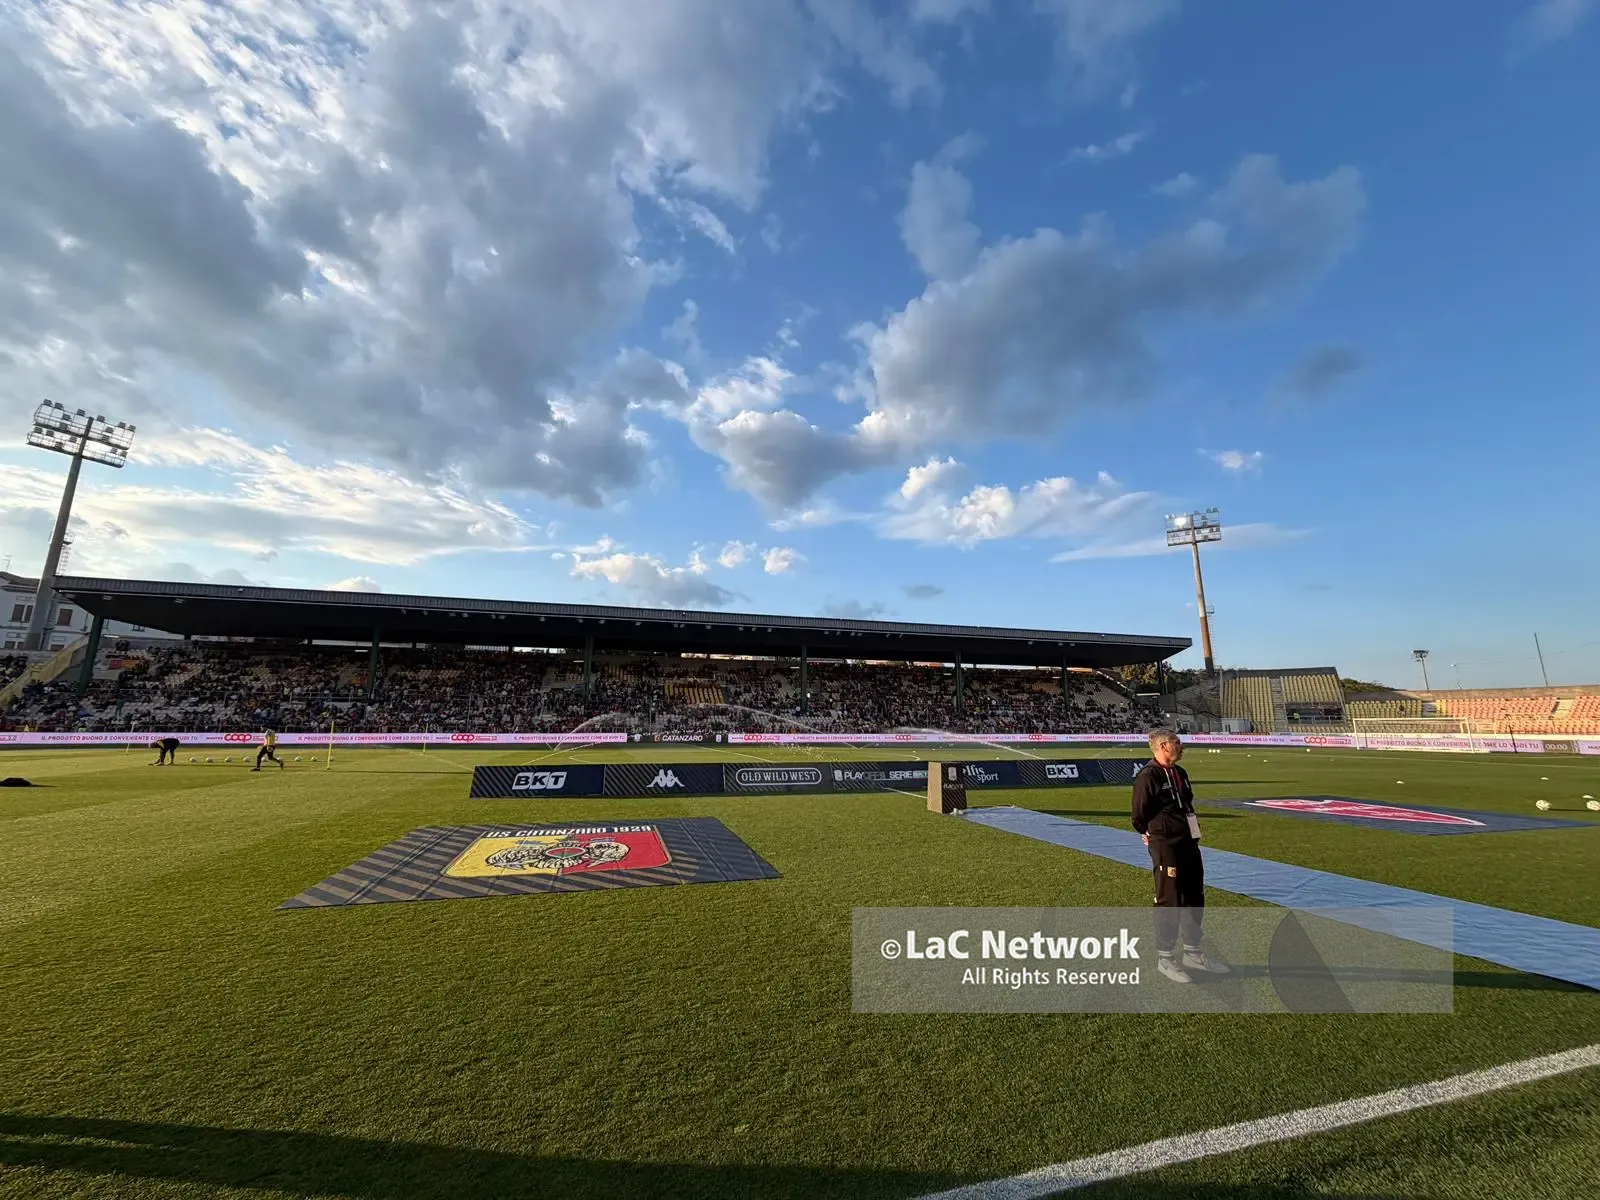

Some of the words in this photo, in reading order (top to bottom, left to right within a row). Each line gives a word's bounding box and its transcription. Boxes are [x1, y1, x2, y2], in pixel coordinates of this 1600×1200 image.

[224, 733, 252, 743] coop
[451, 733, 475, 743] coop
[895, 734, 912, 742] coop
[1304, 736, 1327, 746] coop
[741, 772, 761, 782] OLD
[763, 772, 788, 782] WILD
[789, 771, 817, 781] WEST
[889, 770, 913, 779] SERIE
[1045, 764, 1079, 779] BKT
[512, 771, 567, 790] BKT
[977, 773, 999, 784] sport
[515, 827, 607, 837] CATANZARO
